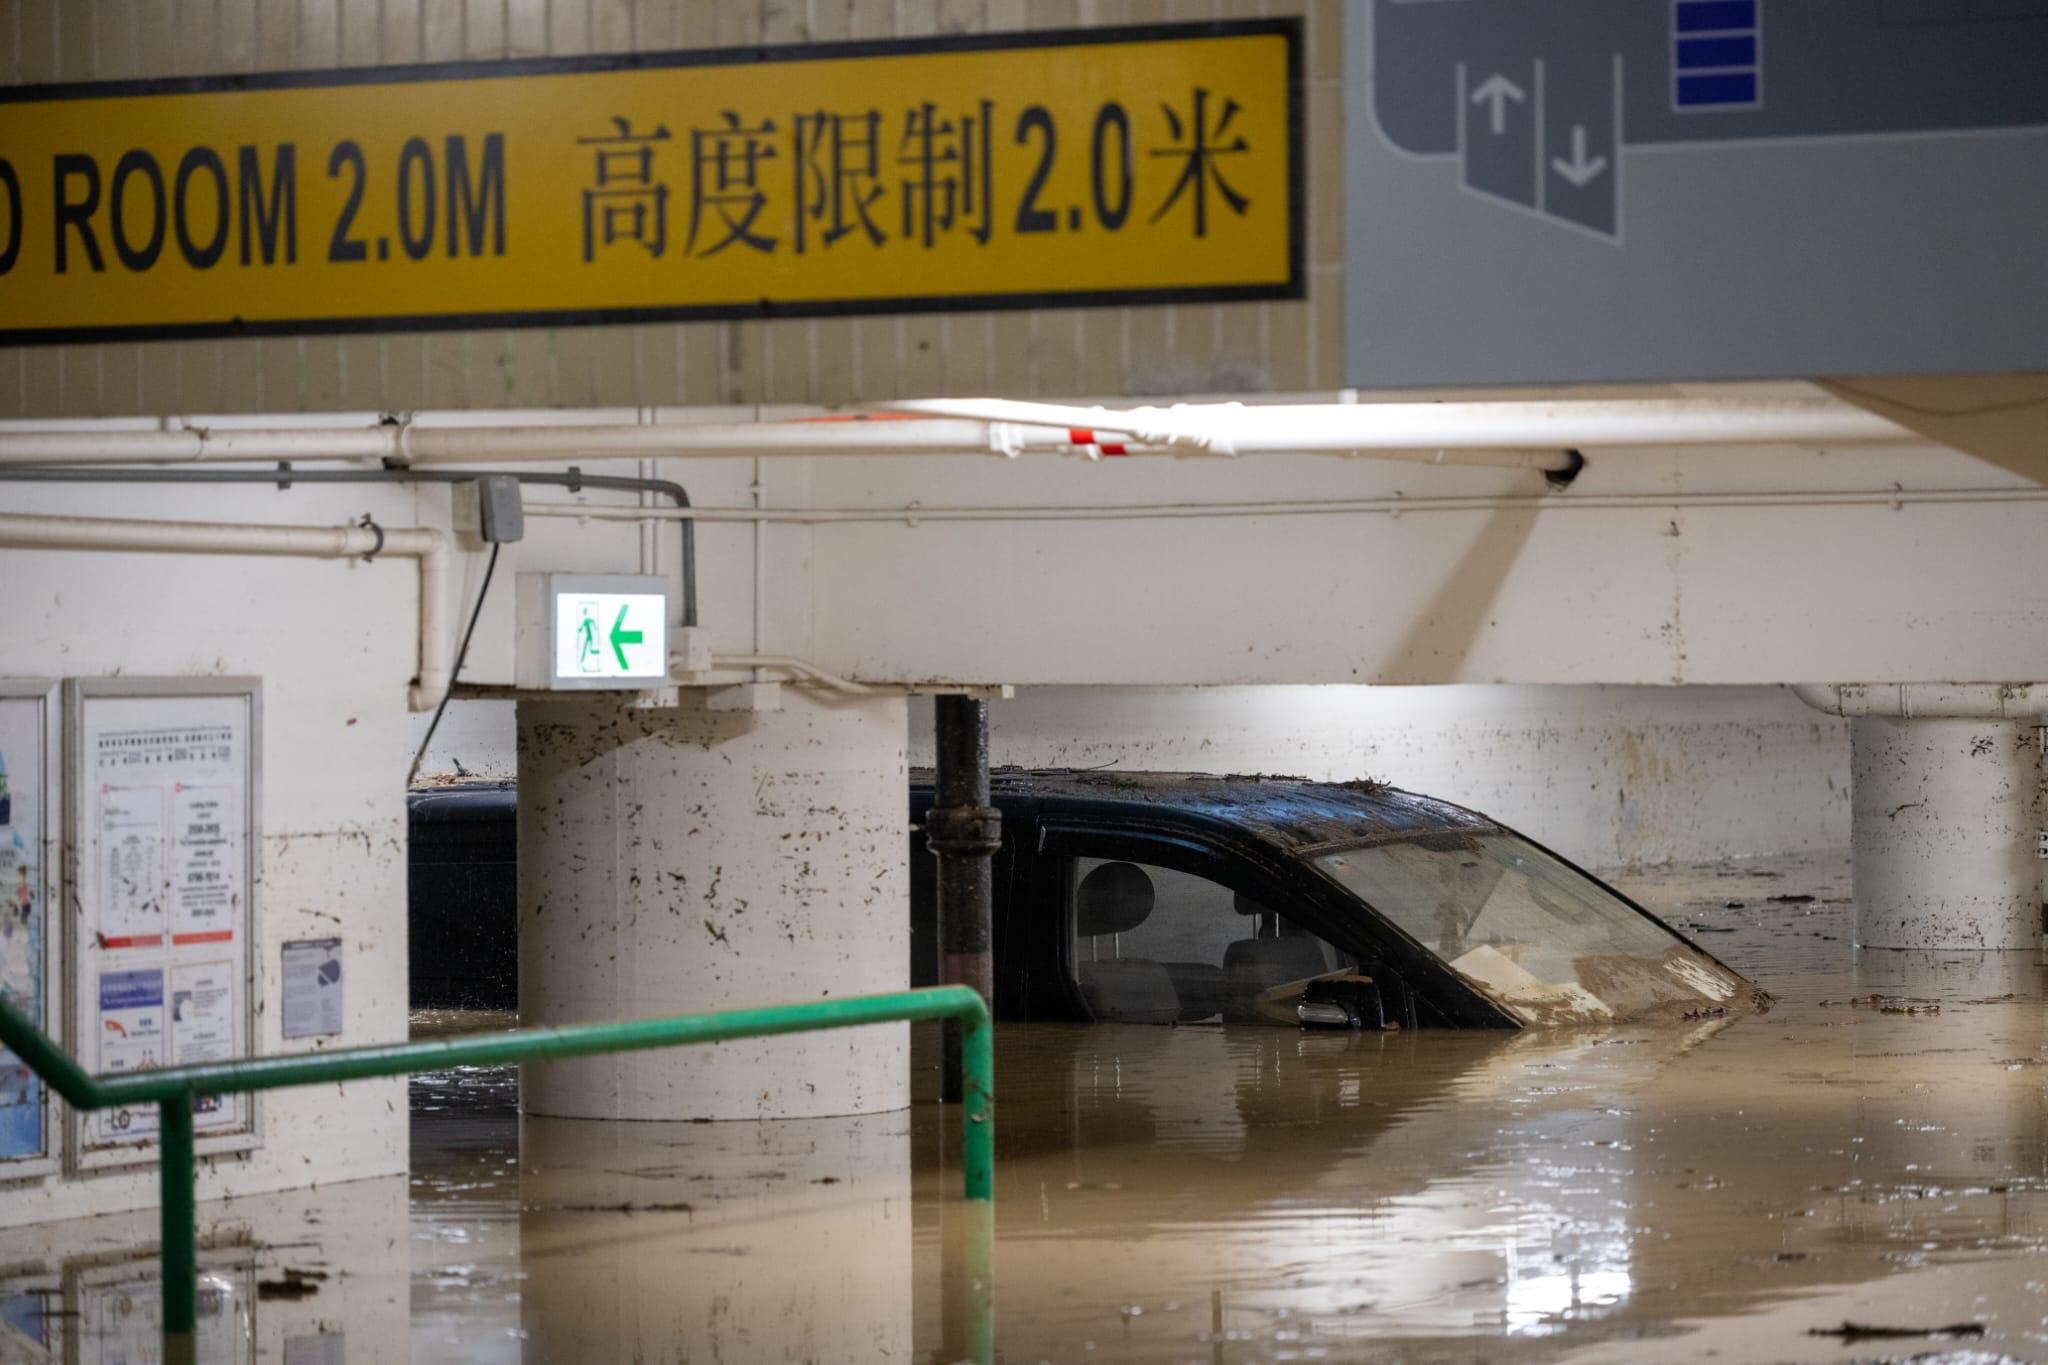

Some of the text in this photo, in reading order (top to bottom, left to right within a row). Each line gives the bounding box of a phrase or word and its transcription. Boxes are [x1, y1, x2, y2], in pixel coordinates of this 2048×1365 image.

[55, 143, 297, 273] ROOM
[327, 132, 505, 265] 2.0M
[576, 87, 1251, 264] 高度限制2.0米
